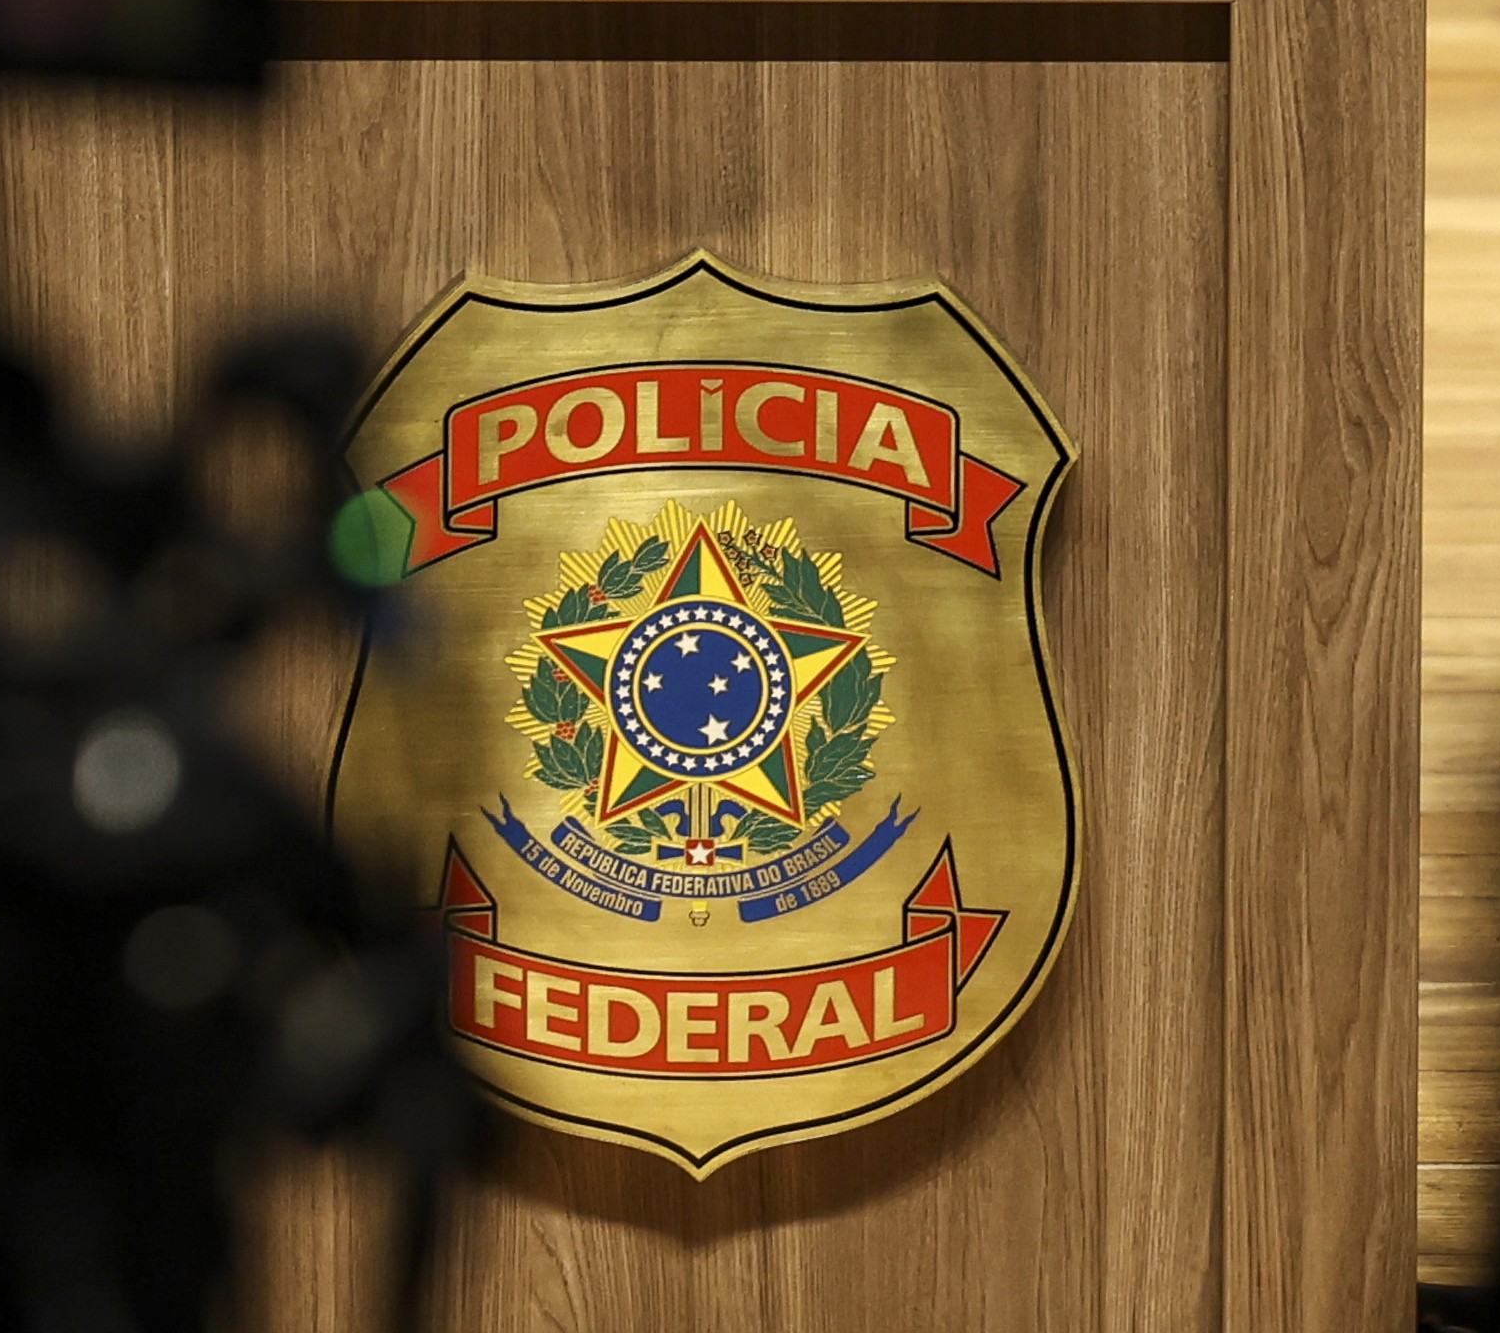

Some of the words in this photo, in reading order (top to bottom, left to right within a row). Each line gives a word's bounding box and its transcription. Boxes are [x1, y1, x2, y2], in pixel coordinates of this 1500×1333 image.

[520, 839, 542, 862] 15
[538, 854, 560, 878] de
[559, 869, 643, 916] Novembro
[775, 891, 798, 913] de
[799, 870, 841, 902] 1889
[651, 872, 755, 896] FEDERATIVA
[756, 865, 782, 888] DO
[782, 835, 841, 878] BRASIL
[473, 954, 925, 1064] FEDERAL
